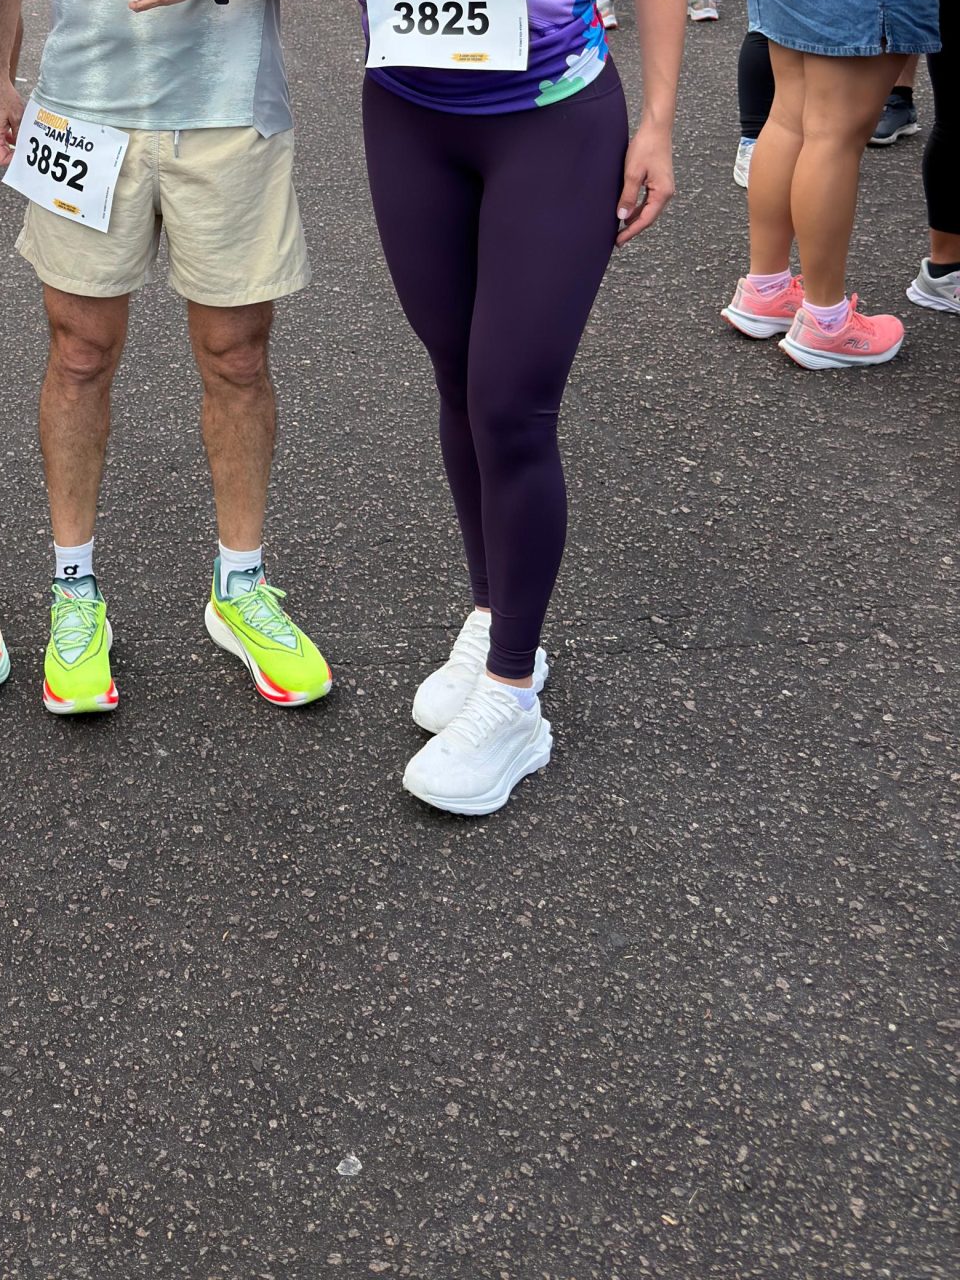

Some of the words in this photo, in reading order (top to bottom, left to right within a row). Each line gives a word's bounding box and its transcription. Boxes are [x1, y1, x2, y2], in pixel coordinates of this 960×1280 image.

[392, 1, 490, 35] 3825
[26, 136, 88, 192] 3852
[843, 338, 870, 352] FILA
